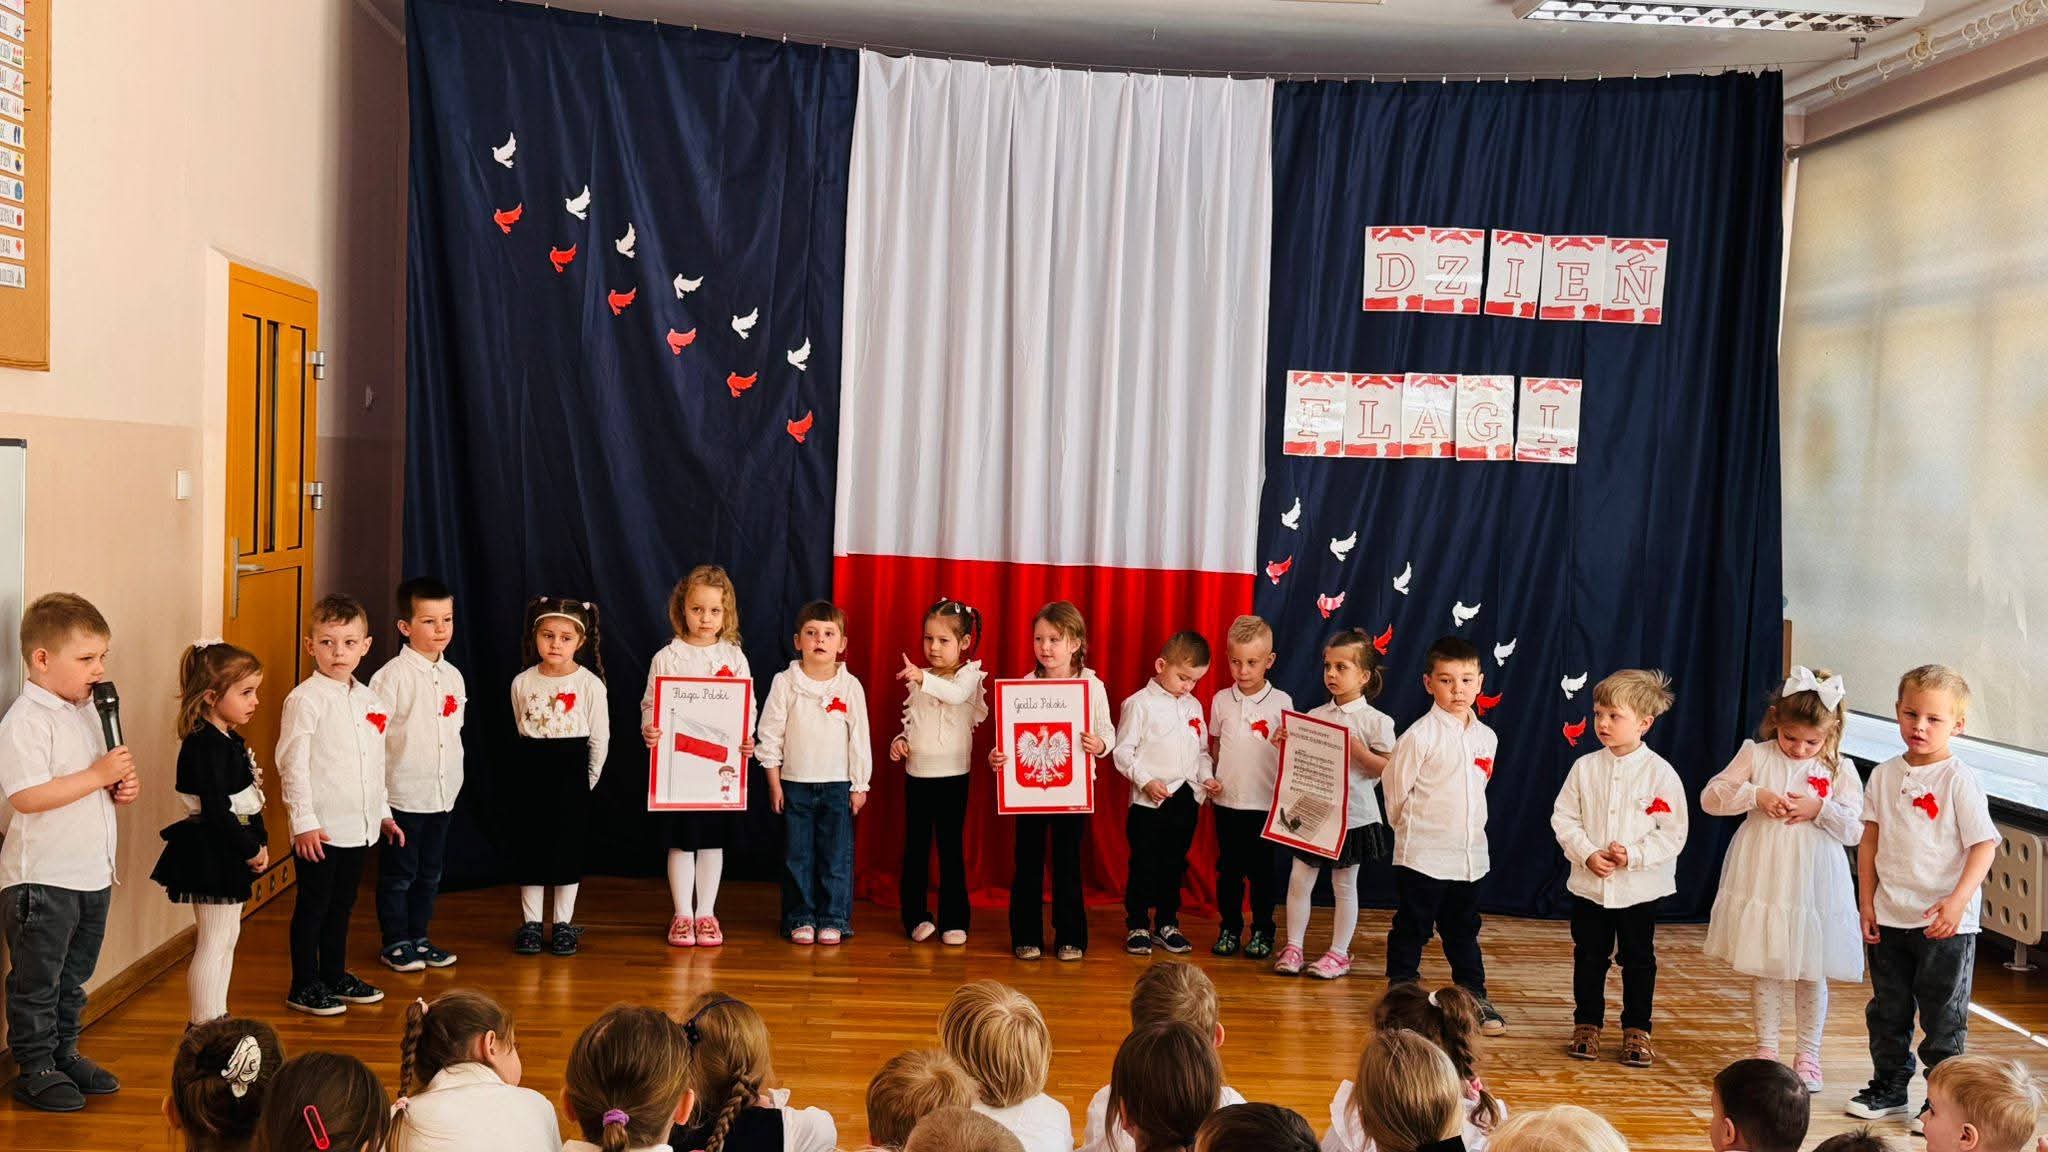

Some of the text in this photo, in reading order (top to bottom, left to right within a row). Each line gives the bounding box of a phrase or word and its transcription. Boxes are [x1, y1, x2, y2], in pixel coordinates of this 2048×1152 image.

[1374, 252, 1658, 306] DZIEŃ
[1297, 397, 1560, 444] FLAGI
[672, 687, 730, 703] Flaga Polski
[1040, 697, 1067, 709] Polski
